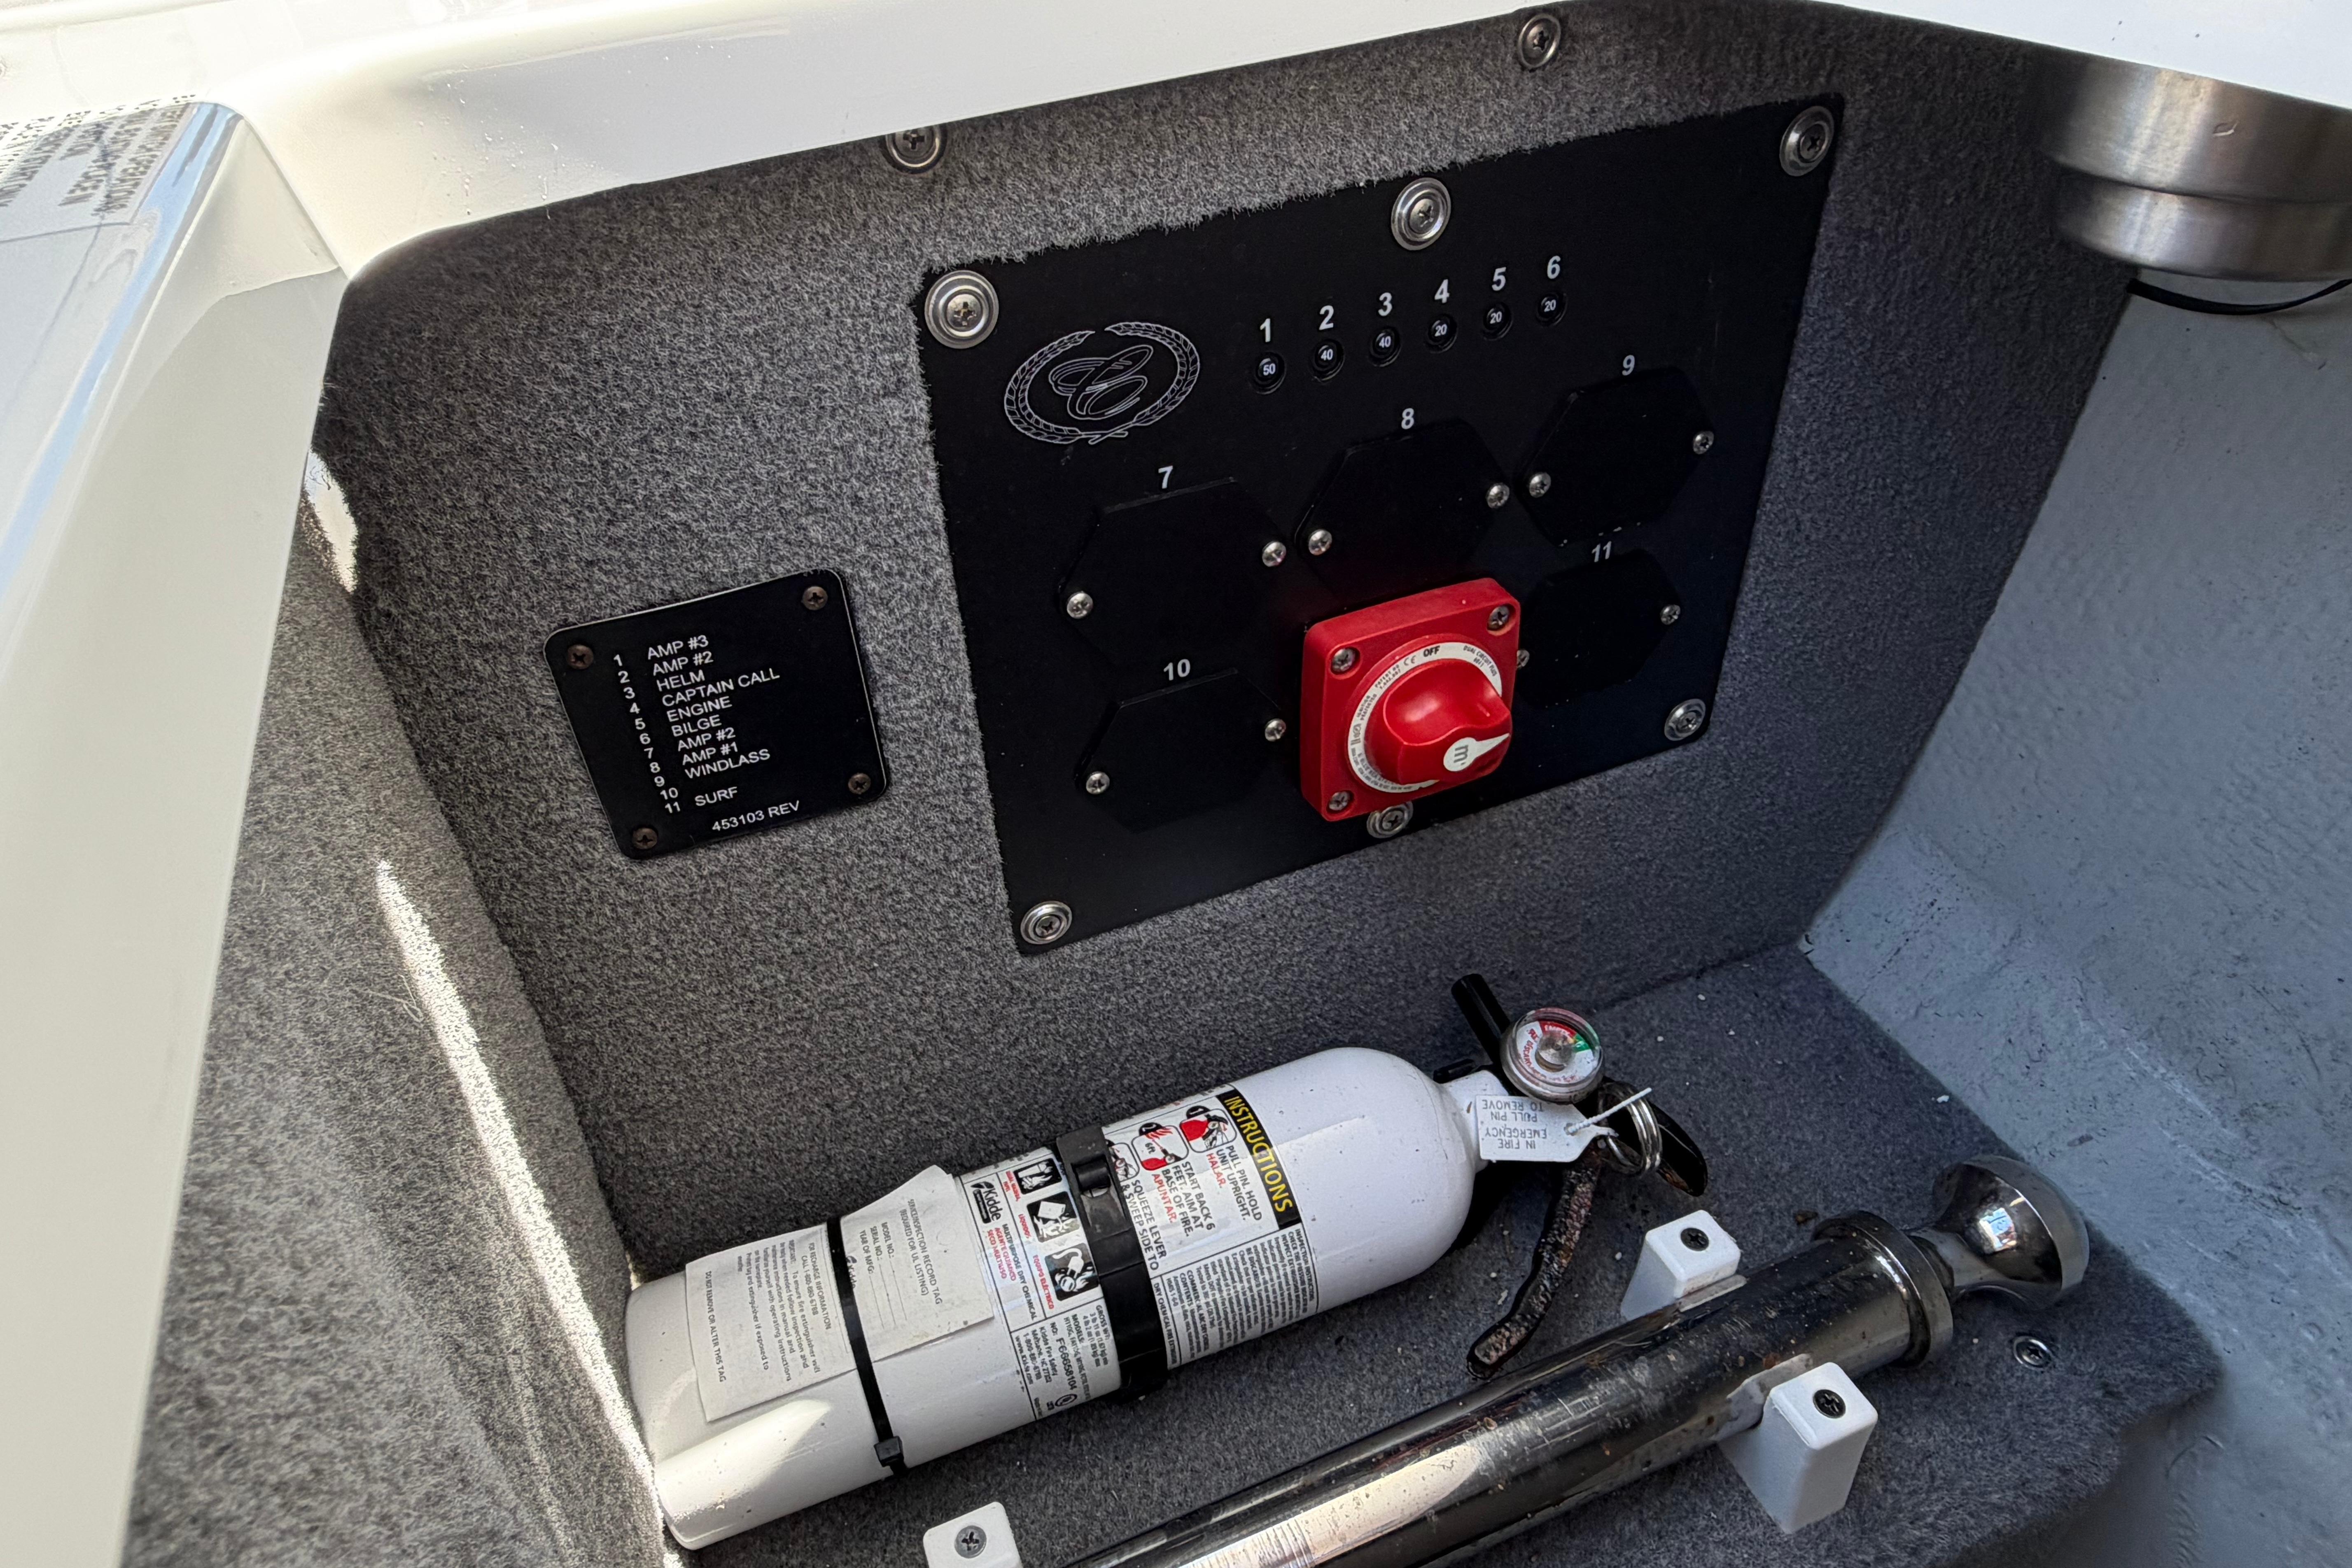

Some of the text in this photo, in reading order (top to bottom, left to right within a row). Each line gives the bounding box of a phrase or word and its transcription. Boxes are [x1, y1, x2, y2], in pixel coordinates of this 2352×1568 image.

[1260, 256, 1561, 342] 1 2 3 4 5 6
[1262, 301, 1556, 376] 50 40 40 20 20 20
[1622, 355, 1635, 375] 9
[1402, 408, 1414, 429] 8
[1158, 466, 1173, 488] 7
[1591, 541, 1612, 562] 11
[614, 635, 709, 666] 1 AMP #3
[1423, 645, 1440, 657] OFF
[619, 652, 713, 683] 2 AMP #2
[1164, 659, 1190, 681] 10
[624, 670, 705, 699] 3 HELM
[630, 668, 780, 714] 4 CAPTAIN CALL
[635, 697, 732, 730] 5 ENGINE
[640, 715, 721, 745] 6 BILGE
[644, 728, 735, 759] 7 AMP #2
[650, 743, 738, 773] 8 AMP #1
[655, 749, 770, 787] 9 WINDLASS
[660, 788, 678, 800] 10
[665, 787, 738, 814] 11 SURF
[712, 801, 800, 831] 453103 REV
[1482, 1099, 1542, 1111] TO REMOVE
[1491, 1111, 1537, 1122] PULL PIN
[1485, 1127, 1547, 1139] EMERGENCY
[1498, 1139, 1535, 1149] IN FIRE
[1144, 1142, 1156, 1154] 6ft
[1223, 1095, 1293, 1213] INSTRUCTIONS
[1206, 1153, 1227, 1188] HALAR.
[1216, 1148, 1251, 1220] UNIT UPRIGHT.
[1225, 1145, 1262, 1221] PULL PIN. HOLD
[982, 1188, 1004, 1222] Kidde
[1152, 1172, 1178, 1223] APUNTAR.
[1161, 1169, 1194, 1237] BASE OF FIRE.
[1171, 1165, 1204, 1230] FEET. AIM AT
[1182, 1161, 1215, 1230] START BACK 6
[881, 1222, 891, 1244] MODEL
[1125, 1192, 1144, 1228] SWEEP
[1138, 1229, 1153, 1255] SIDE
[1147, 1255, 1159, 1271] TO
[1132, 1179, 1167, 1258] SQUEEZE LEVER
[859, 1230, 868, 1245] YEAR
[862, 1244, 870, 1255] OF
[870, 1226, 880, 1244] SERIAL
[986, 1229, 996, 1245] SECO
[994, 1227, 1007, 1251] AGENTE
[705, 1271, 711, 1279] DO
[907, 1237, 929, 1296] FOR UL LISTING)
[922, 1254, 943, 1304] RECORD TAG
[1001, 1223, 1038, 1321] MULTIPURPOSE DRY CHEMICAL
[767, 1290, 775, 1303] with
[782, 1272, 792, 1293] needed
[808, 1252, 820, 1280] RECHARGE
[814, 1281, 832, 1330] INFORMATION
[1153, 1283, 1162, 1296] DRY
[786, 1294, 796, 1315] follow
[1095, 1304, 1108, 1327] GROSS
[707, 1314, 715, 1325] OR
[747, 1286, 758, 1323] extinguisher
[755, 1330, 768, 1360] exposed
[762, 1361, 769, 1370] to
[768, 1304, 781, 1338] operating
[780, 1311, 791, 1337] manual
[786, 1339, 795, 1353] and
[791, 1270, 798, 1279] To
[800, 1314, 815, 1358] extinguisher
[811, 1359, 820, 1373] will
[710, 1325, 719, 1348] ALTER
[791, 1316, 805, 1353] inspection
[1039, 1326, 1050, 1346] Kidde
[714, 1348, 722, 1365] THIS
[777, 1338, 792, 1381] instructions
[799, 1354, 809, 1369] and
[717, 1365, 726, 1382] TAG
